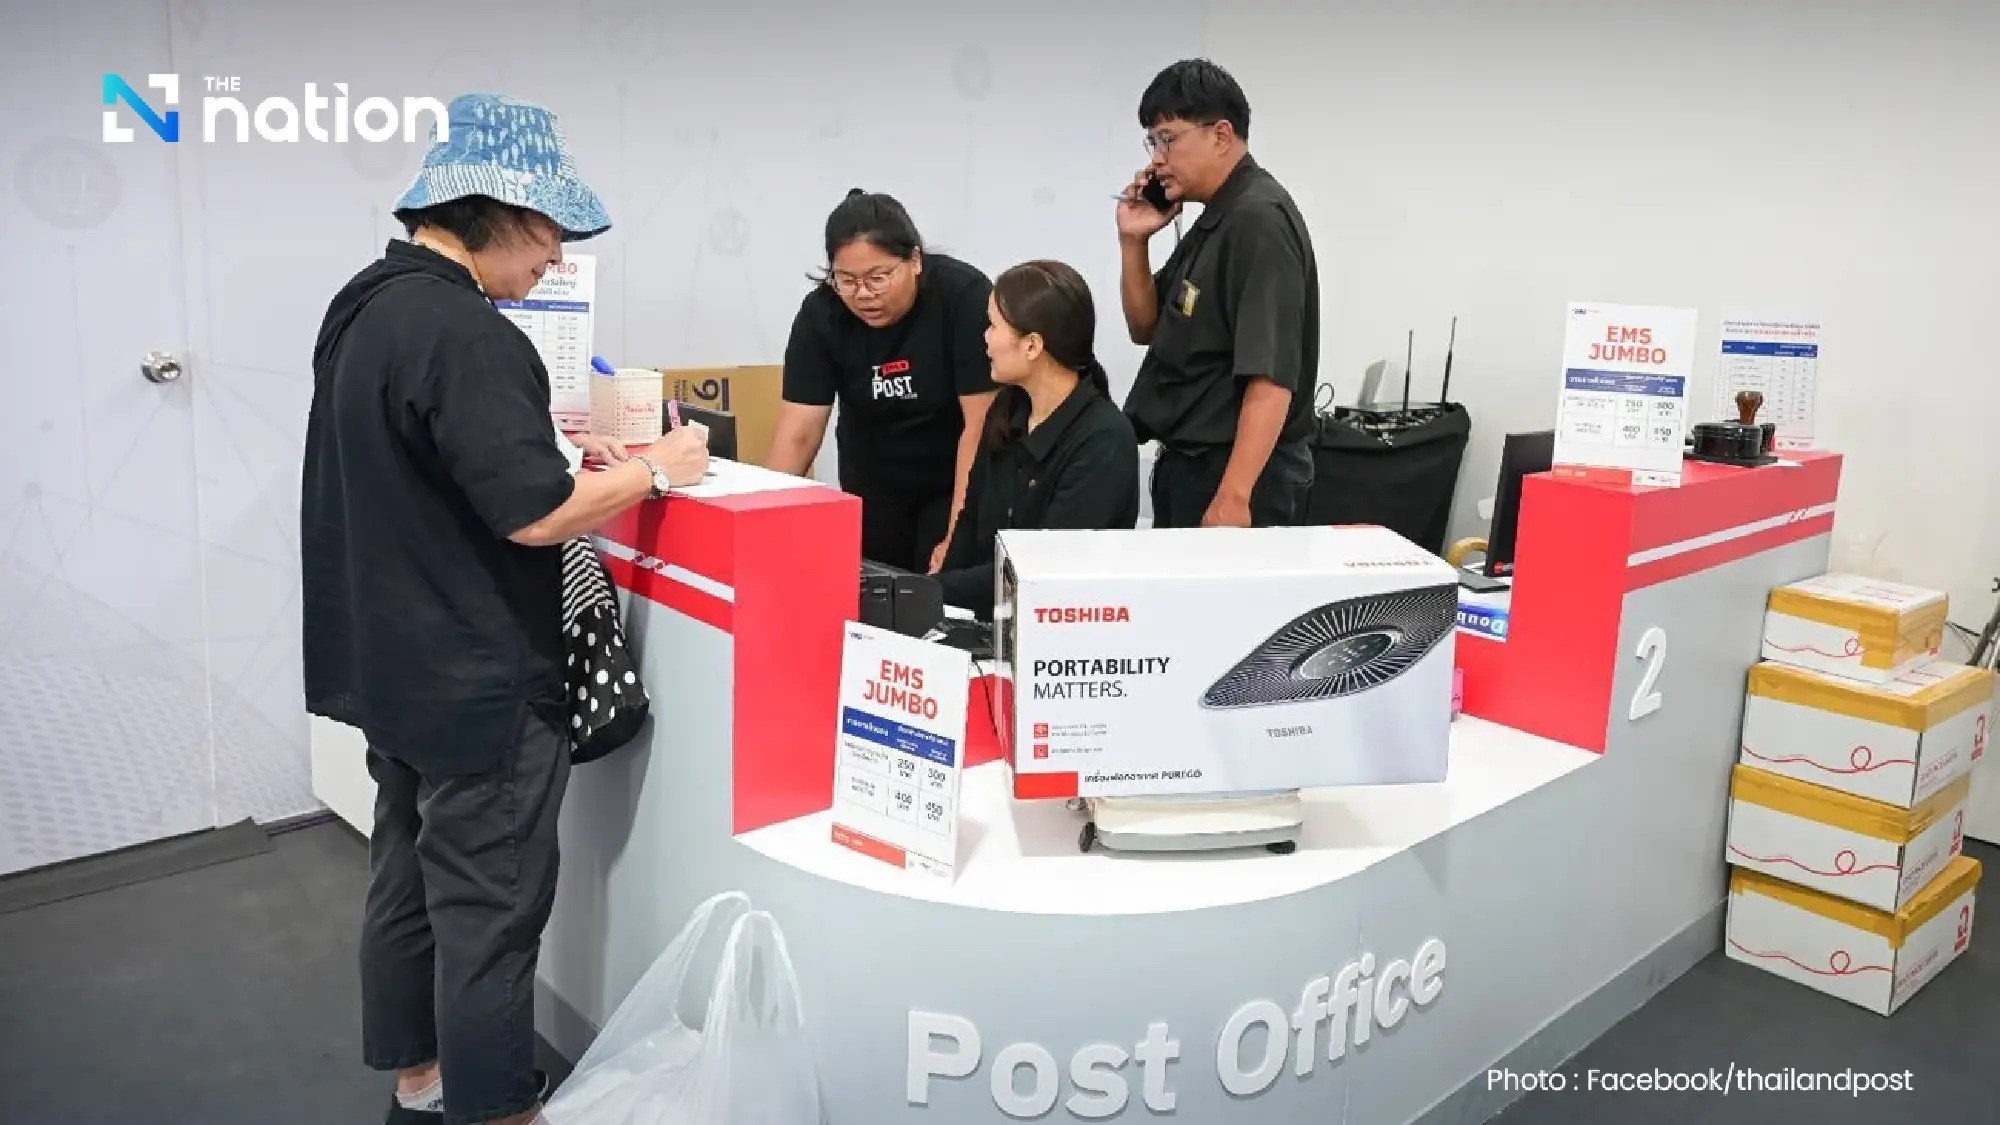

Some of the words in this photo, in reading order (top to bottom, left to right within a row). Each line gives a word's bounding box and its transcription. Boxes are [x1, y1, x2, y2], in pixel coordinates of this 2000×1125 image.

[545, 262, 578, 275] MBO
[1606, 325, 1652, 345] EMS
[1588, 342, 1667, 364] JUMBO
[872, 365, 883, 380] I
[872, 376, 912, 400] POST
[1034, 607, 1130, 623] TOSHIBA
[1457, 611, 1505, 634] Doub
[881, 659, 924, 690] EMS
[1034, 657, 1170, 677] PORTABILITY
[1628, 627, 1667, 721] 2
[863, 680, 938, 719] JUMBO
[1034, 680, 1127, 699] MATTERS.
[1266, 725, 1312, 738] TOSHIBA
[897, 758, 915, 772] 250
[928, 768, 946, 783] 300
[1161, 769, 1203, 780] PUREGO
[895, 791, 913, 804] 400
[925, 801, 944, 817] 450
[907, 1009, 1180, 1119] Post
[1216, 937, 1447, 1097] Office
